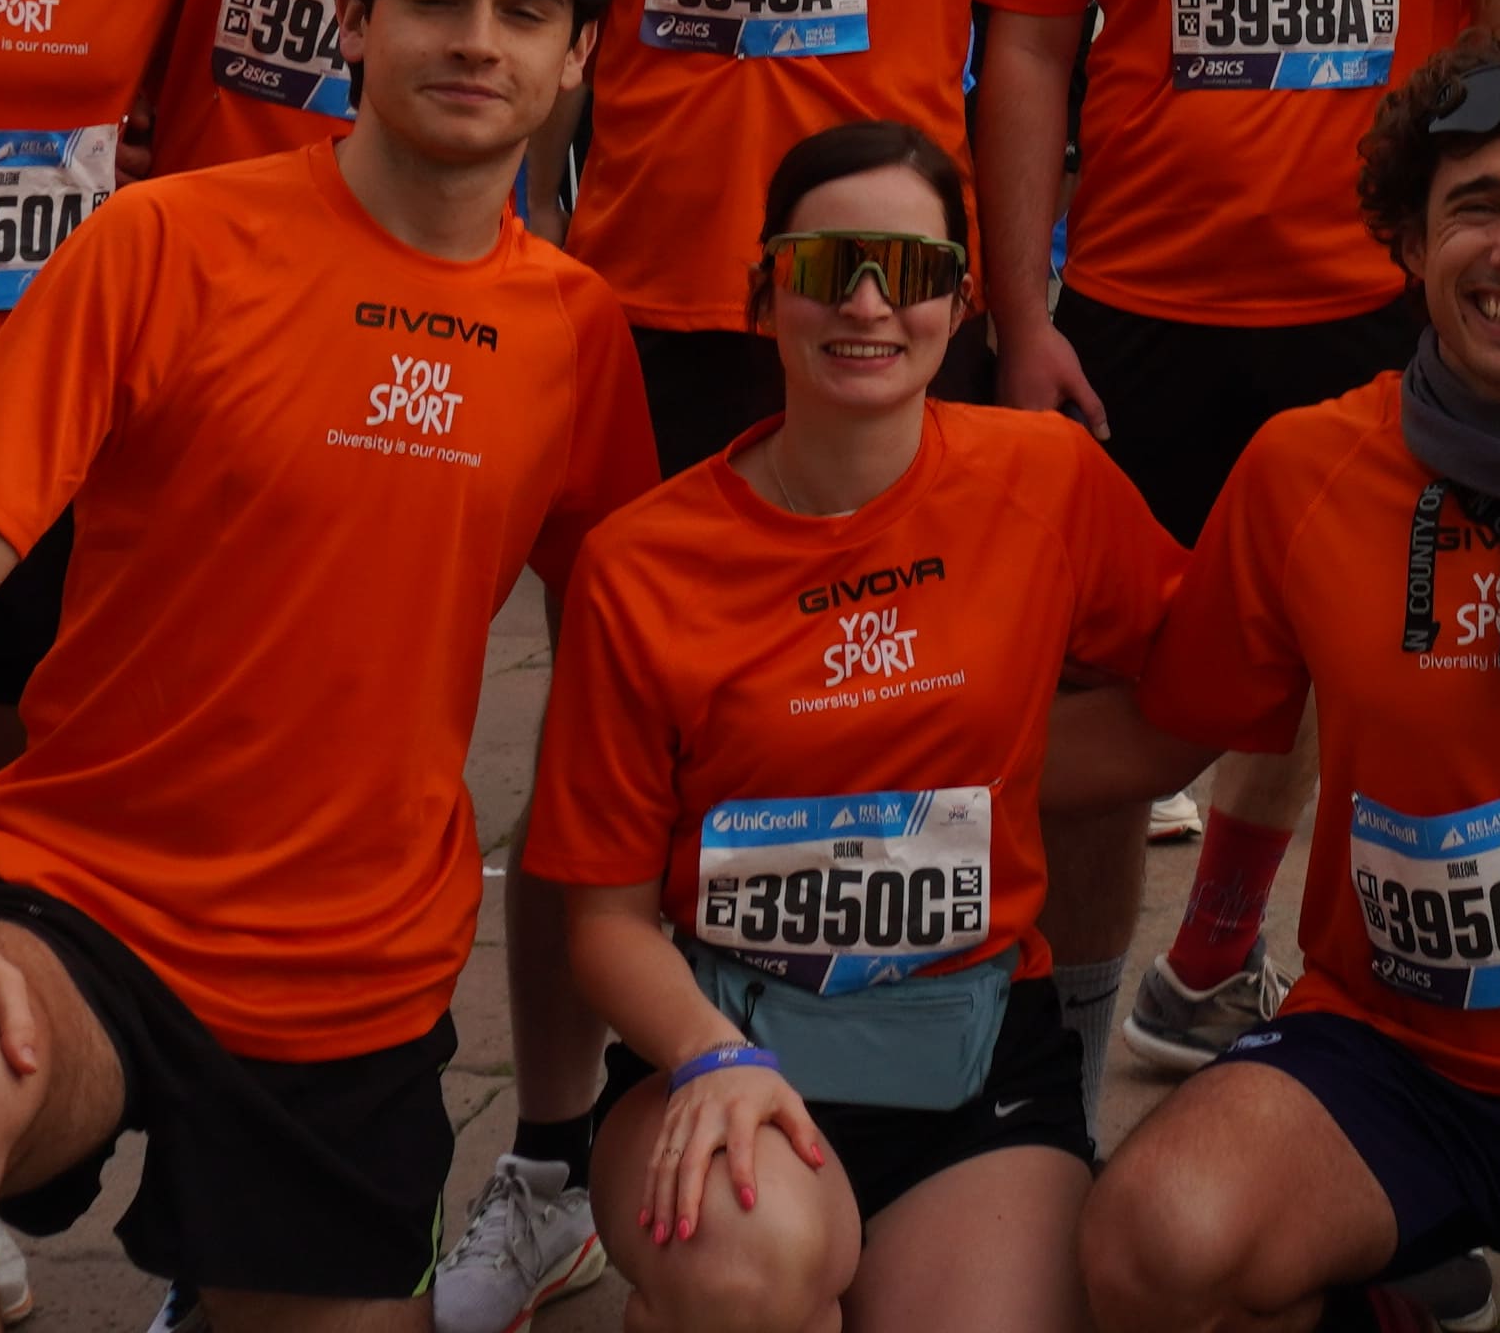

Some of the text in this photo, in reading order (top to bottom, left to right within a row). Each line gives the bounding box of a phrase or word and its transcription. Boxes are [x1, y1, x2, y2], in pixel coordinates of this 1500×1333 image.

[1, 37, 14, 51] is
[16, 39, 40, 53] our
[42, 41, 89, 56] normal
[675, 21, 711, 38] asics
[241, 62, 283, 88] asics
[1205, 59, 1244, 76] asics
[20, 140, 59, 152] RELAY
[355, 301, 498, 352] GIVOVA
[391, 354, 451, 401] YOU
[366, 384, 463, 436] SPORT
[327, 429, 483, 468] Diversity is our normal
[1419, 484, 1445, 511] OF
[1410, 516, 1436, 615] COUNTY
[798, 556, 946, 614] GIVOVA
[838, 606, 898, 652] YOU
[823, 629, 918, 687] SPORT
[1419, 652, 1489, 672] Diversity
[790, 669, 966, 715] Diversity is our normal
[733, 804, 901, 832] UniCredit RELAY
[1367, 812, 1418, 845] UniCredit
[833, 841, 864, 859] SOLEONE
[740, 866, 946, 947] 3950C
